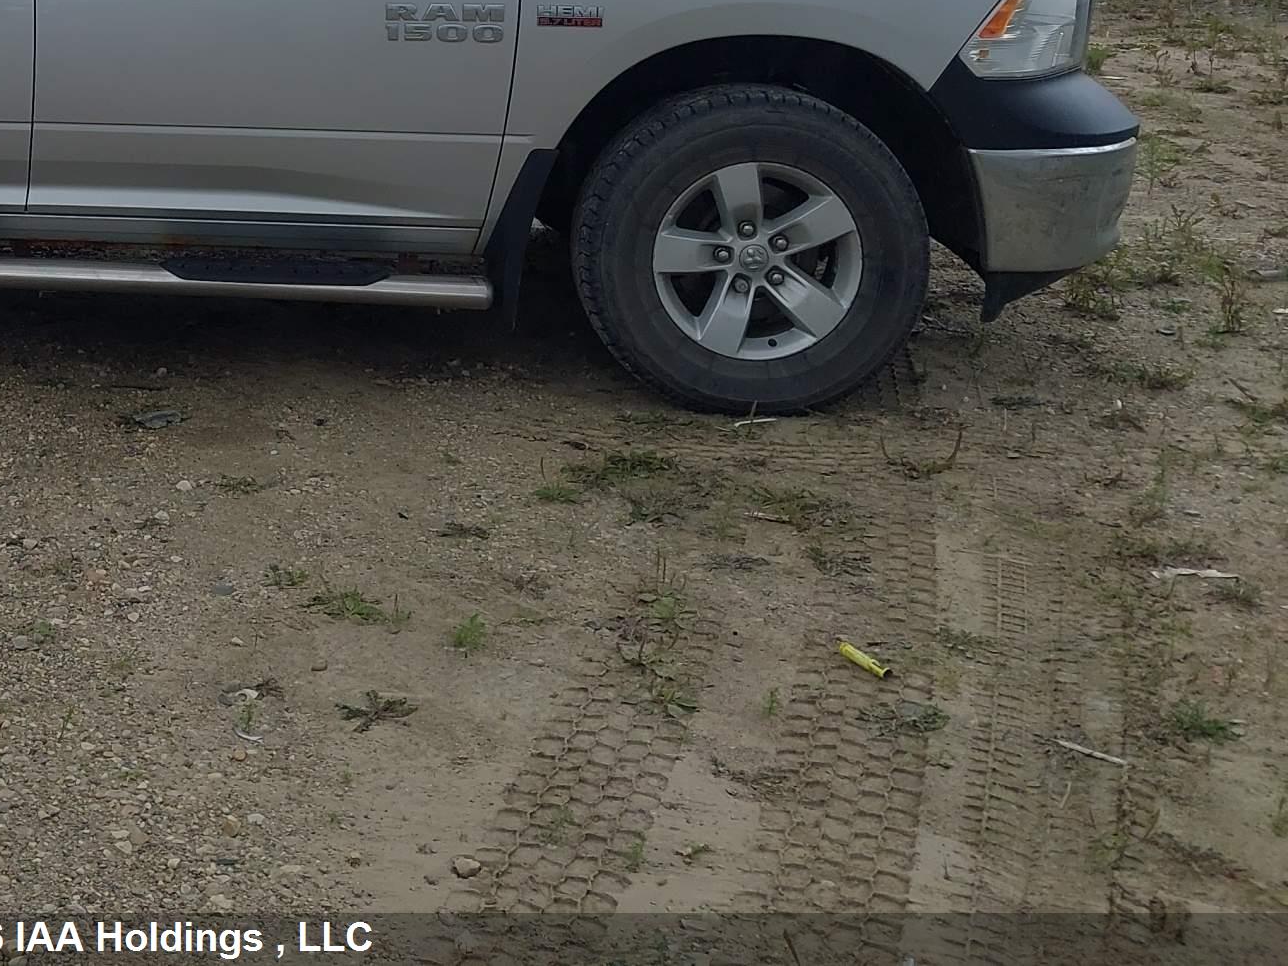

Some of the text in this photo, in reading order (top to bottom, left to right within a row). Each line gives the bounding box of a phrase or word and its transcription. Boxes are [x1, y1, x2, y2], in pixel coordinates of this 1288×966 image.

[385, 2, 505, 23] RAM
[537, 4, 604, 18] HEMI
[385, 23, 504, 43] 1500
